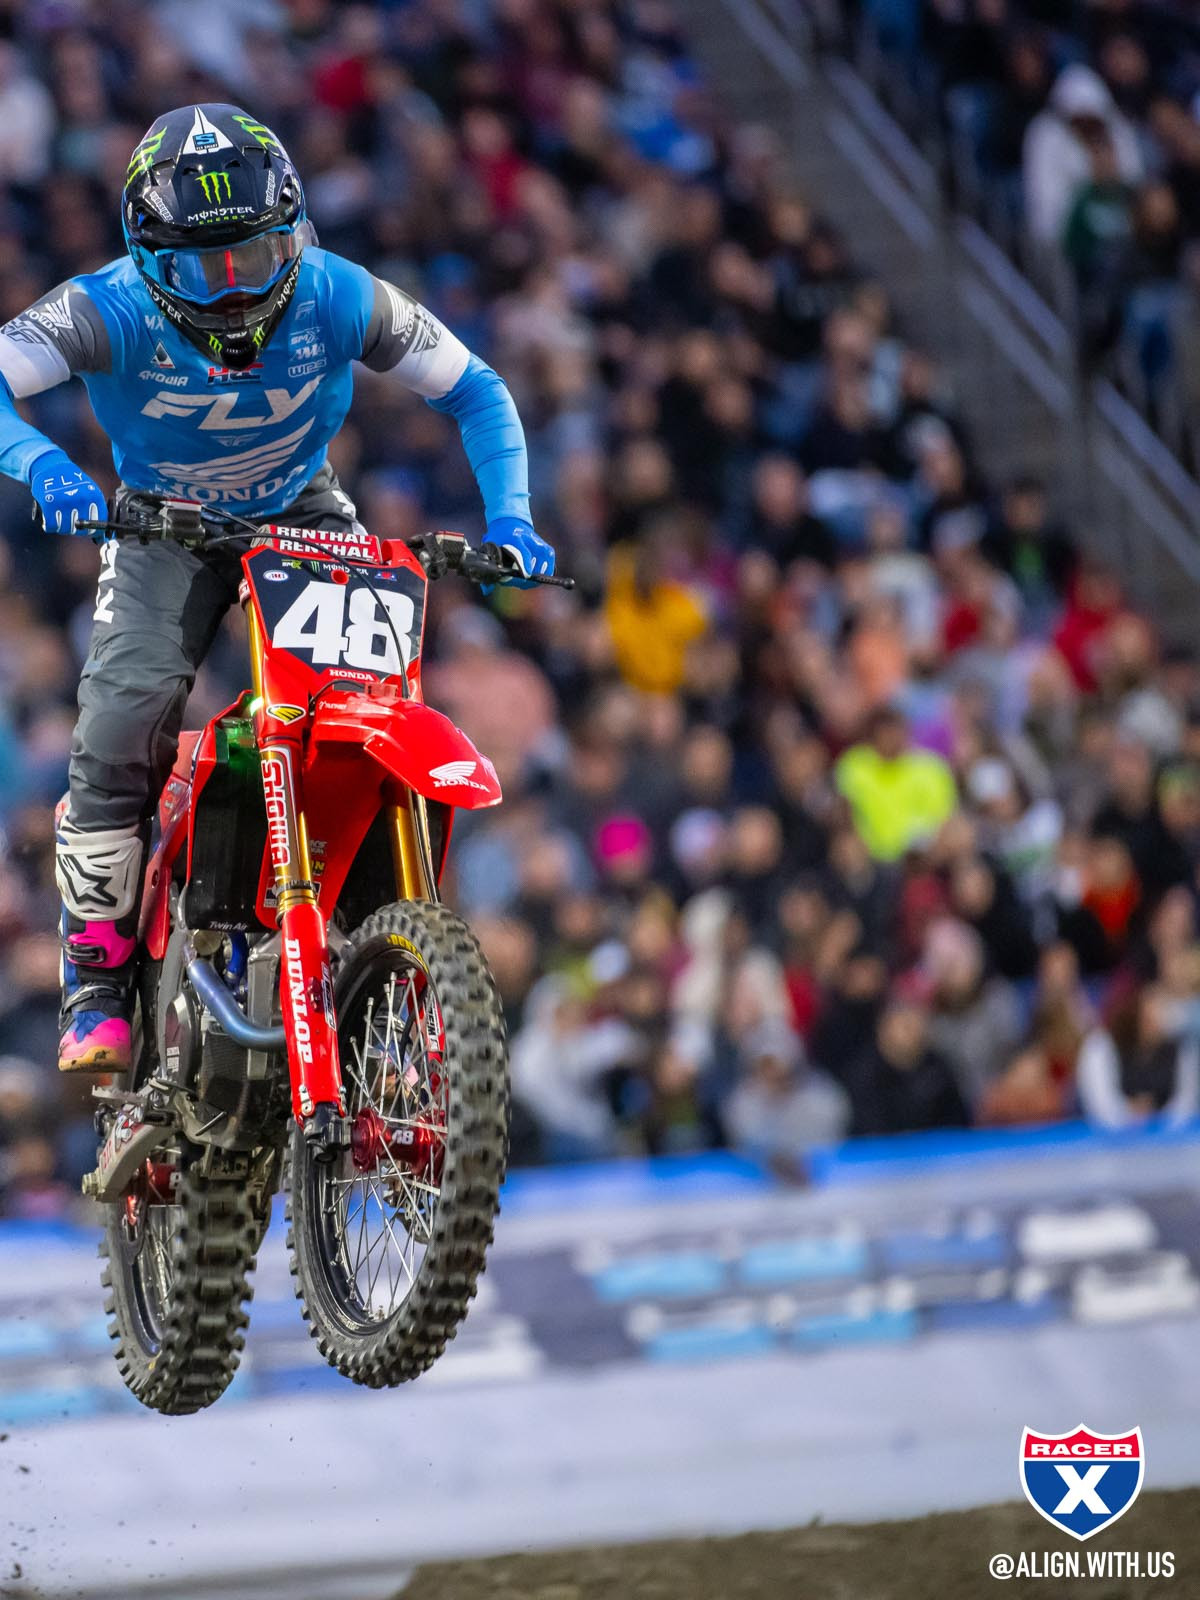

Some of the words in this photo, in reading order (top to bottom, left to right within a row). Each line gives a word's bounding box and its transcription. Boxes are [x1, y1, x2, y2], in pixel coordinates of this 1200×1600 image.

[187, 206, 255, 223] MONSTER
[141, 276, 183, 323] NSTER
[138, 370, 189, 387] SHOWA
[141, 374, 326, 430] FLY
[44, 471, 84, 490] FLY
[170, 464, 308, 502] HONDA
[277, 526, 373, 545] RENTHAL
[323, 563, 369, 576] MONSER
[272, 580, 415, 676] 48
[329, 669, 375, 681] HONDA
[434, 776, 490, 792] HONDA
[261, 759, 291, 868] SHOWA
[209, 920, 231, 930] Twin
[232, 922, 249, 931] Air
[285, 938, 313, 1064] DUNLOP
